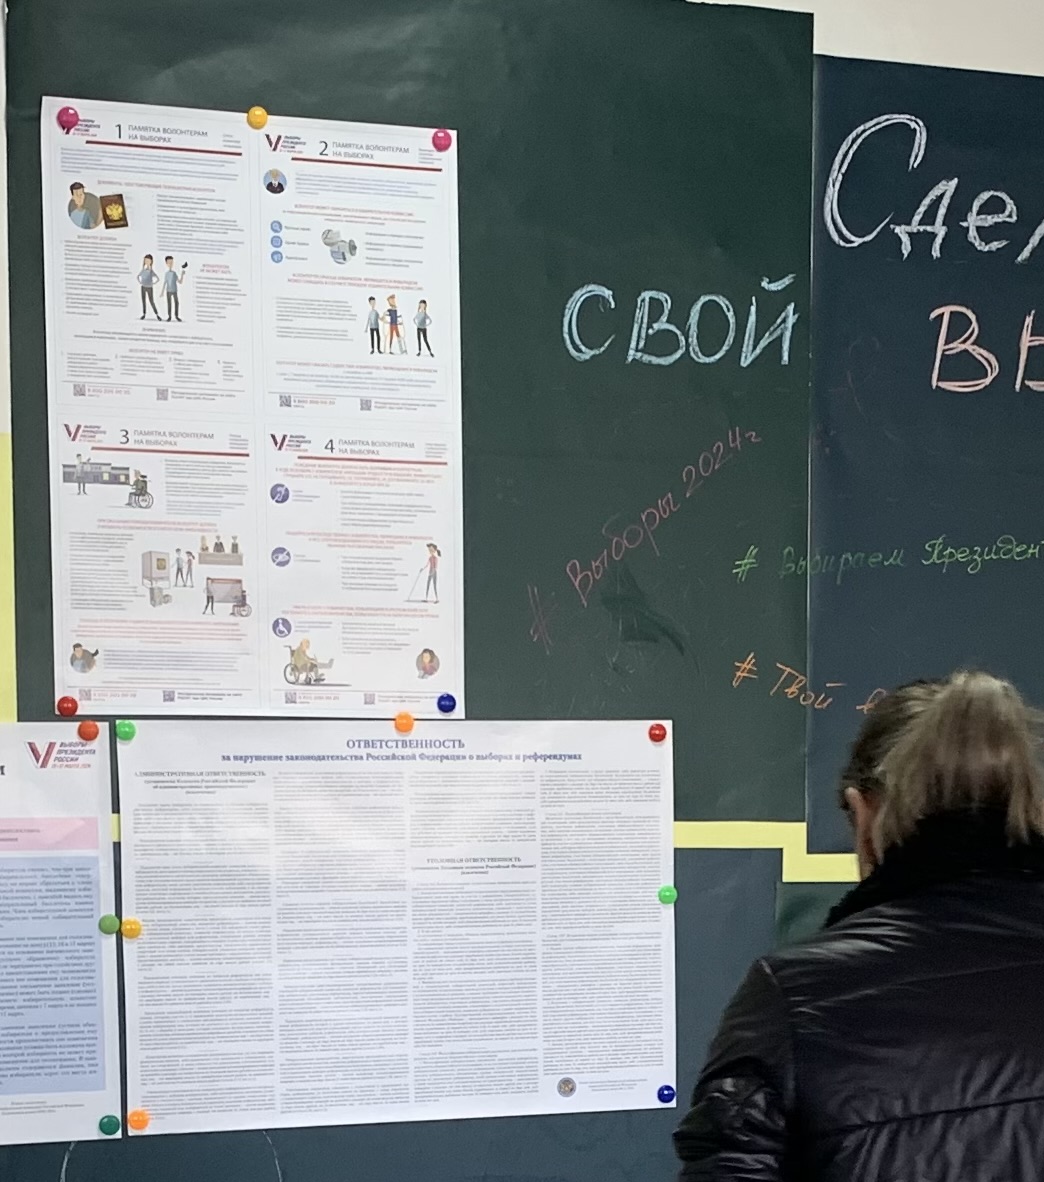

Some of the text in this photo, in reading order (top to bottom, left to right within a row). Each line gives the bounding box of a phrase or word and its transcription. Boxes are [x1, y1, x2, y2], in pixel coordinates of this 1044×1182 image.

[115, 124, 208, 139] 1 ПАМЯТКА ВОЛОНТЕРАМ
[319, 140, 329, 156] 2
[119, 429, 129, 444] 3
[324, 439, 335, 453] 4
[346, 739, 465, 750] ОТВЕТСТВЕННОСТЬ
[233, 754, 284, 763] нарушение
[285, 753, 364, 762] законодательства
[366, 753, 417, 761] Российской
[418, 752, 467, 763] Федерации
[522, 752, 583, 763] референдумах
